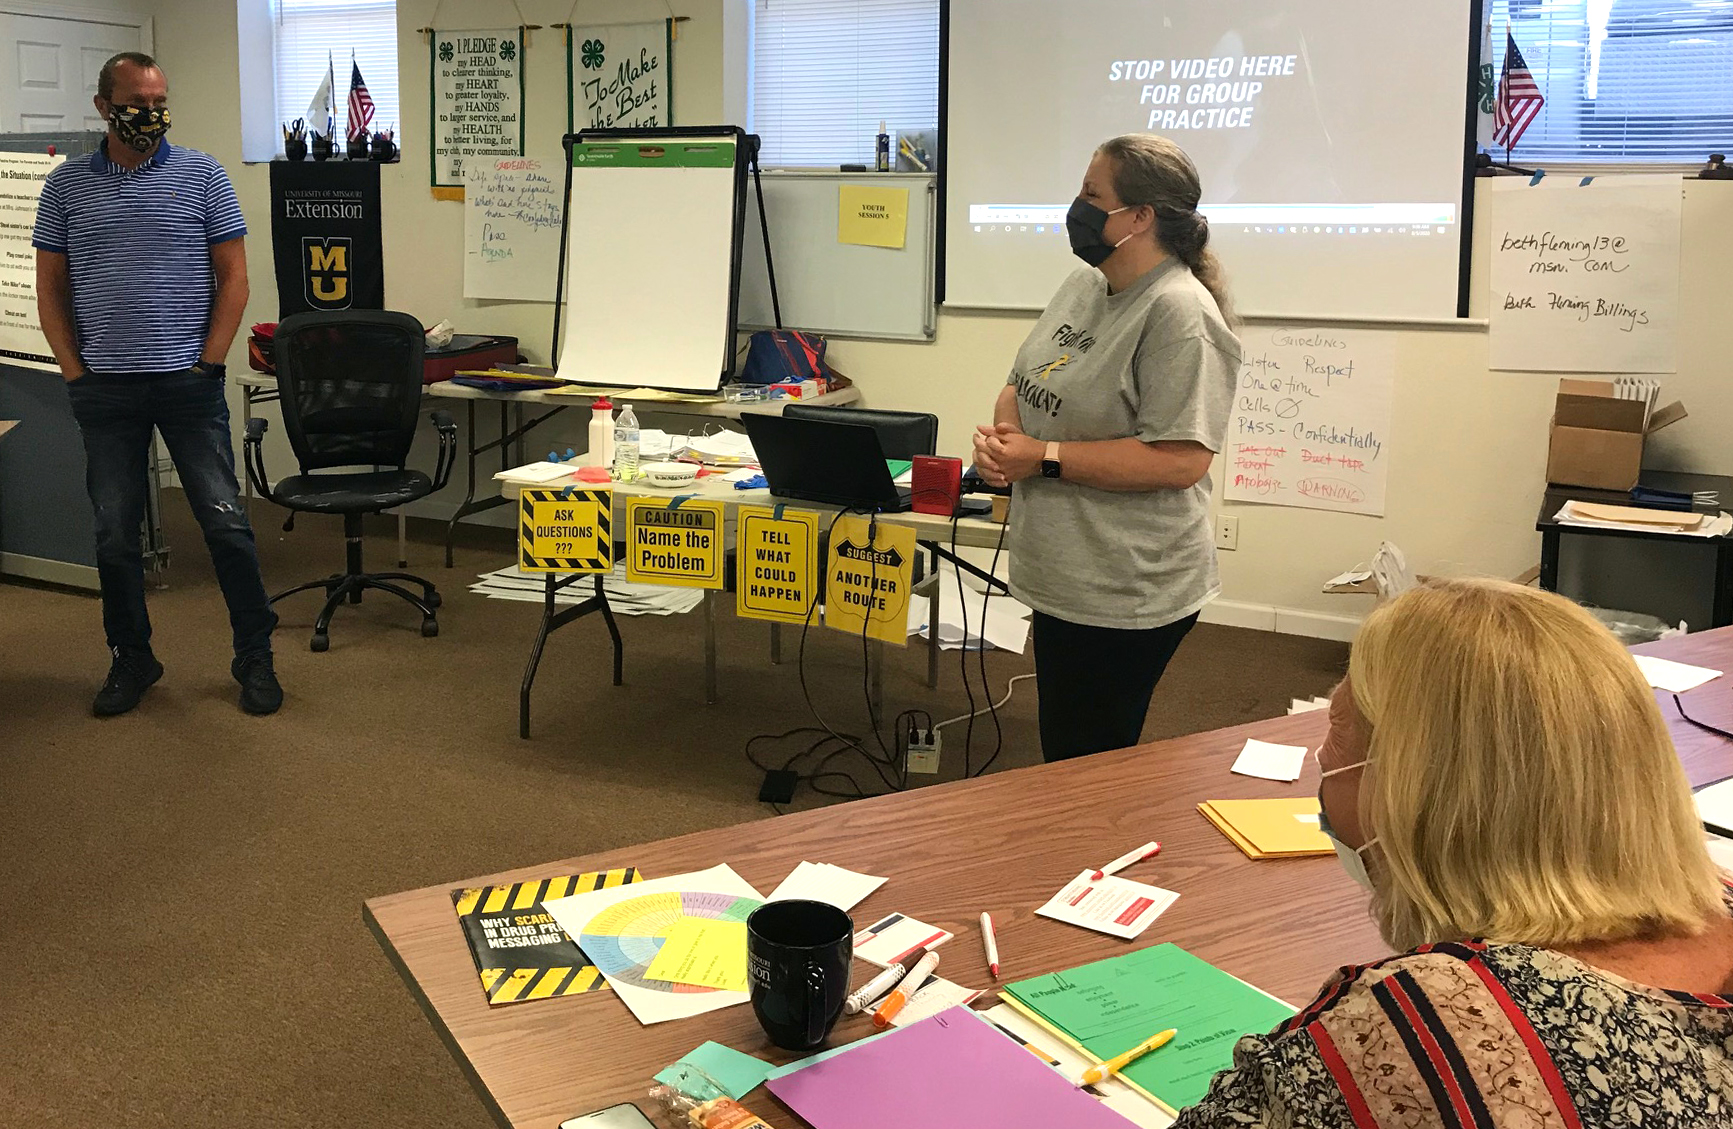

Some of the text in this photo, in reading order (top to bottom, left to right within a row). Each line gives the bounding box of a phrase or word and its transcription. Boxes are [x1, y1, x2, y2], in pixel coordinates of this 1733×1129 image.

[463, 38, 496, 53] PLEDGE
[470, 56, 496, 67] HEAD
[1109, 55, 1297, 81] STOP VIDEO HERE
[443, 69, 450, 77] to
[609, 47, 658, 95] Make
[466, 79, 499, 89] HEART
[445, 91, 453, 99] to
[615, 79, 657, 121] Best
[1140, 82, 1262, 104] FOR GROUP
[465, 102, 499, 112] HANDS
[440, 114, 448, 122] to
[501, 113, 516, 122] and
[1148, 107, 1254, 129] PRACTICE
[462, 124, 502, 134] HEALTH
[444, 136, 451, 144] to
[501, 136, 513, 145] for
[437, 148, 448, 156] my
[463, 148, 476, 156] my
[285, 190, 321, 198] UNIVERSITY
[333, 190, 363, 198] MISSOURI
[285, 199, 363, 218] Extension
[1593, 297, 1650, 333] Billings
[1238, 416, 1276, 435] PASS
[554, 509, 574, 521] ASK
[645, 511, 703, 526] CAUTION
[536, 526, 593, 538] QUESTIONS
[638, 527, 710, 549] Name the
[762, 530, 791, 545] TELL
[555, 542, 573, 554] ???
[642, 550, 705, 571] Problem
[755, 548, 791, 564] WHAT
[846, 547, 893, 565] SUGGEST
[755, 566, 796, 582] COULD
[836, 570, 897, 593] ANOTHER
[750, 585, 801, 602] HAPPEN
[843, 590, 886, 610] ROUTE
[480, 918, 511, 929] WHY
[483, 928, 499, 939] IN
[500, 925, 537, 938] DRUG
[487, 933, 562, 949] MESSAGING
